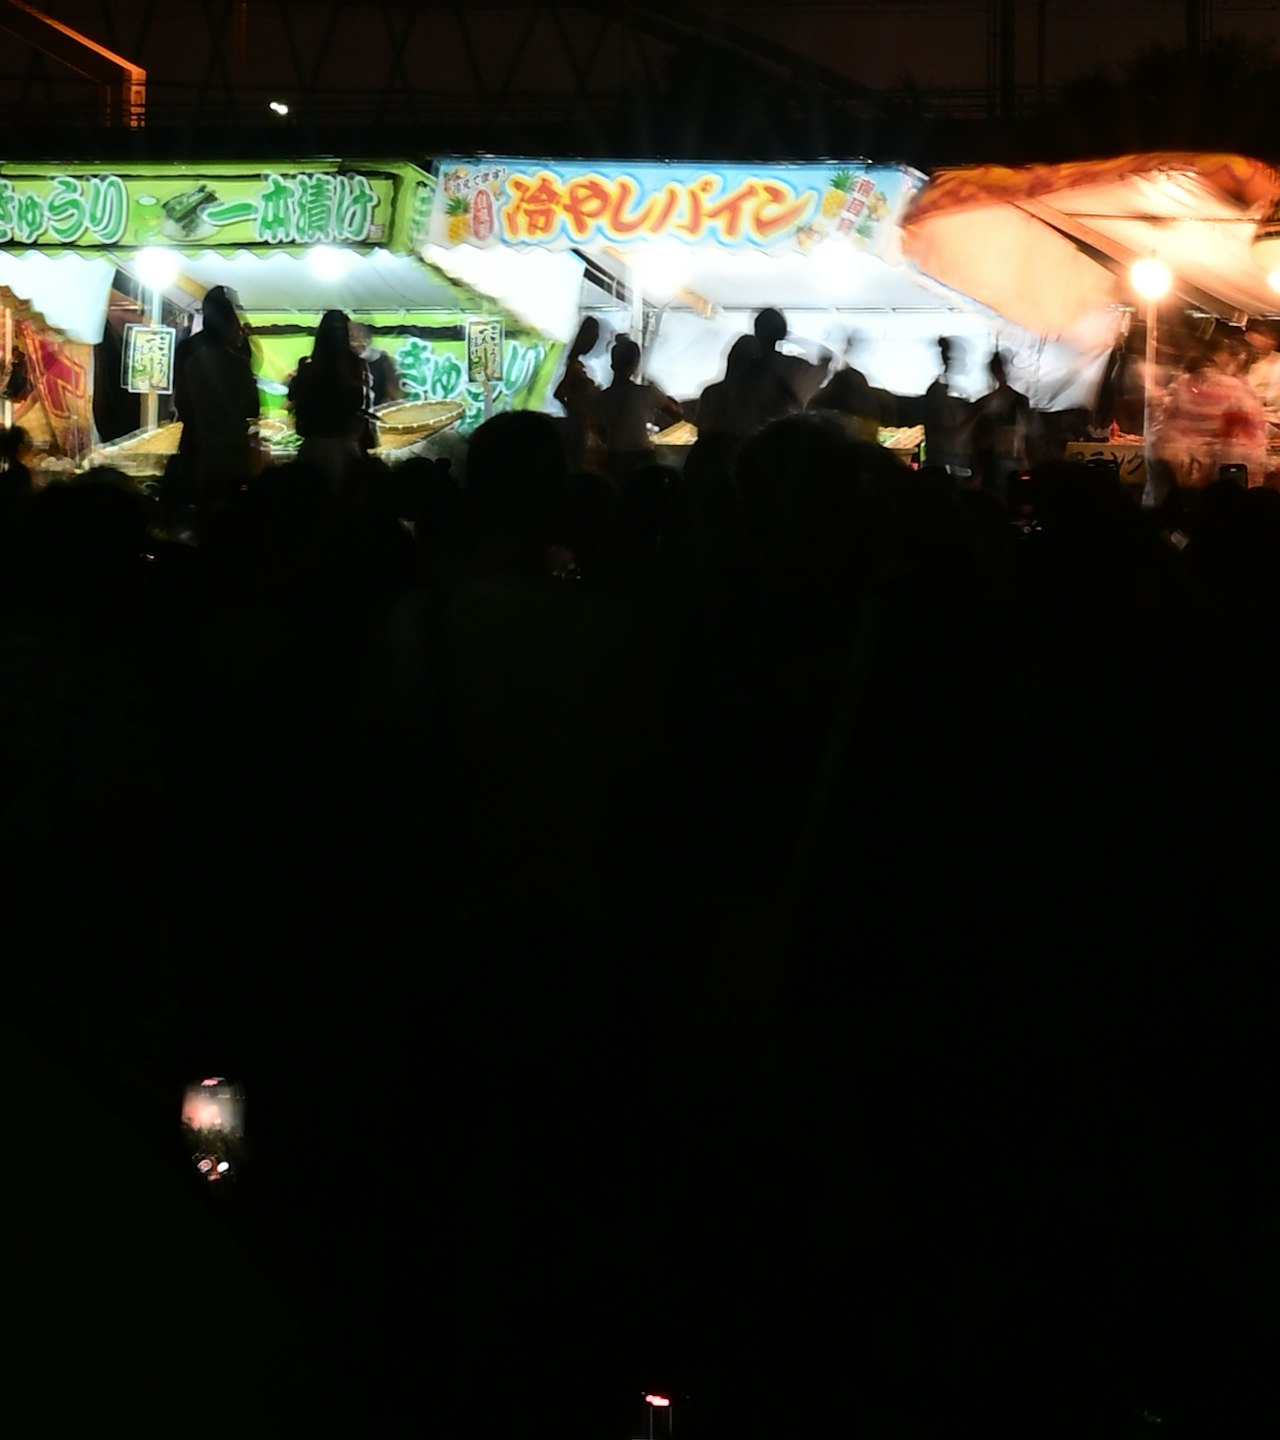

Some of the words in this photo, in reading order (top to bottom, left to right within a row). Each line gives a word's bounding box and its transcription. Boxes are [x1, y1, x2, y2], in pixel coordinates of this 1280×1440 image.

[205, 175, 378, 244] 一本漬け
[505, 175, 811, 238] 冷やしパイン
